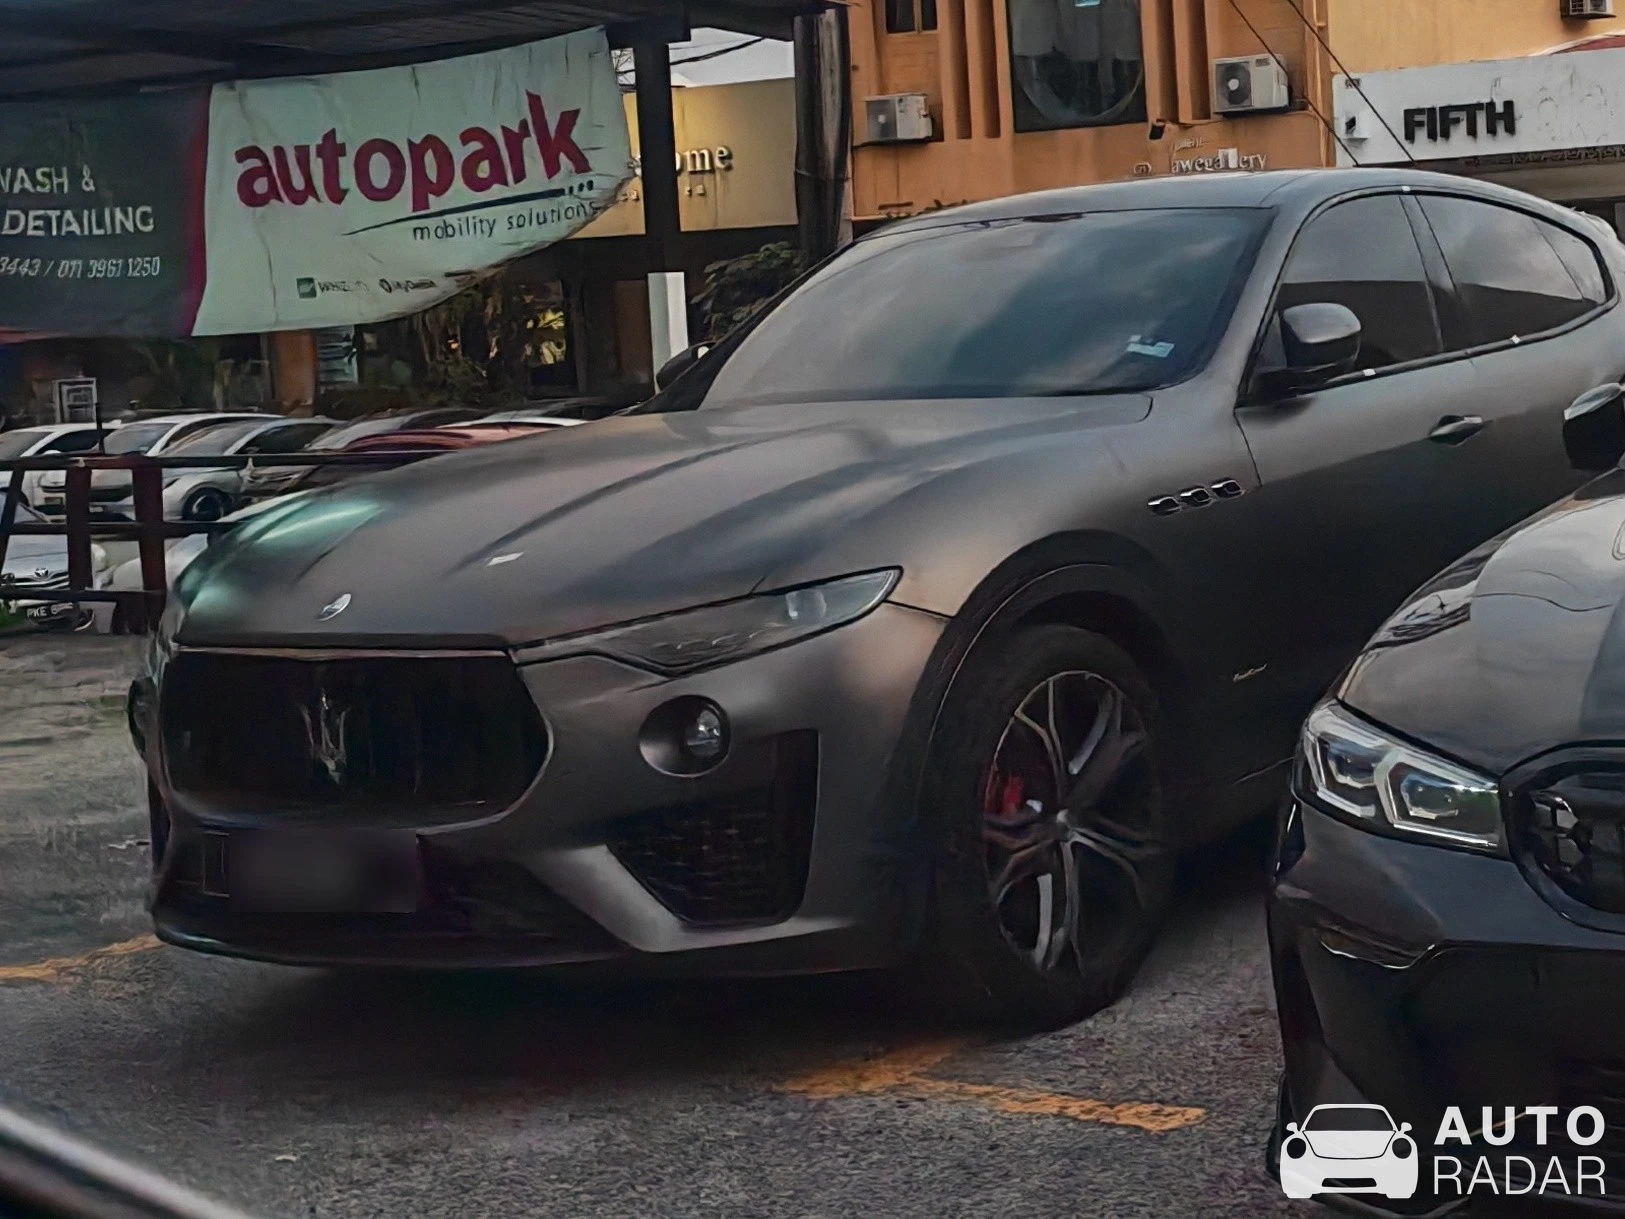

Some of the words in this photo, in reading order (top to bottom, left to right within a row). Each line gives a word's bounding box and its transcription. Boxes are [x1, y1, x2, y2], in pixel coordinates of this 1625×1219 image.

[1403, 99, 1517, 144] FIFTH
[235, 89, 593, 213] autopark
[81, 164, 96, 193] &
[1, 205, 155, 237] DETAILING
[413, 215, 497, 241] mobility
[507, 200, 600, 231] solutions
[127, 255, 161, 277] 1250
